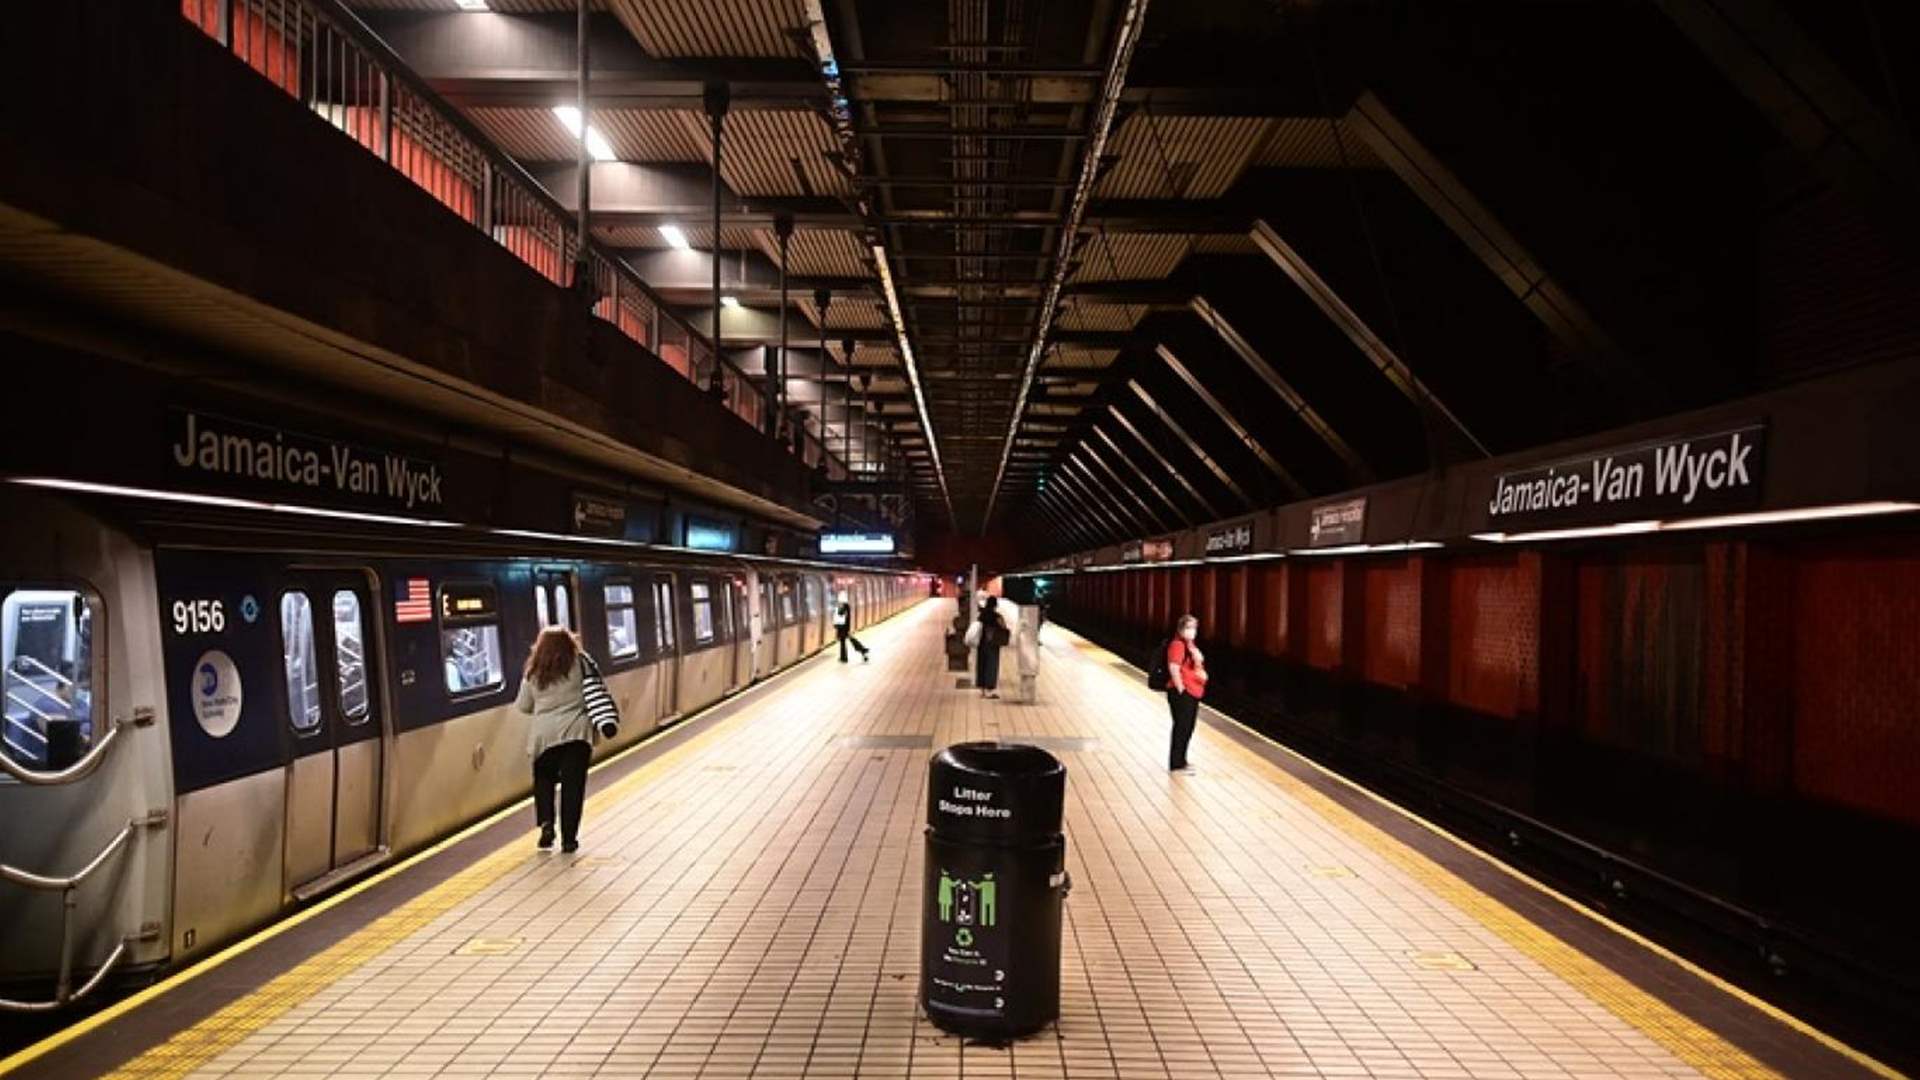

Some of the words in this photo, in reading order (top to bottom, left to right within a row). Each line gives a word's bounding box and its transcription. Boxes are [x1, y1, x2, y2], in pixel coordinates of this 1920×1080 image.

[174, 413, 379, 494] Jamaica-Van
[385, 455, 442, 507] Wyck
[1489, 457, 1644, 514] Jamaica-Van
[1656, 433, 1752, 504] Wyck
[172, 600, 225, 633] 9156
[442, 594, 451, 616] E
[953, 786, 993, 801] Litter
[976, 804, 1012, 818] Here
